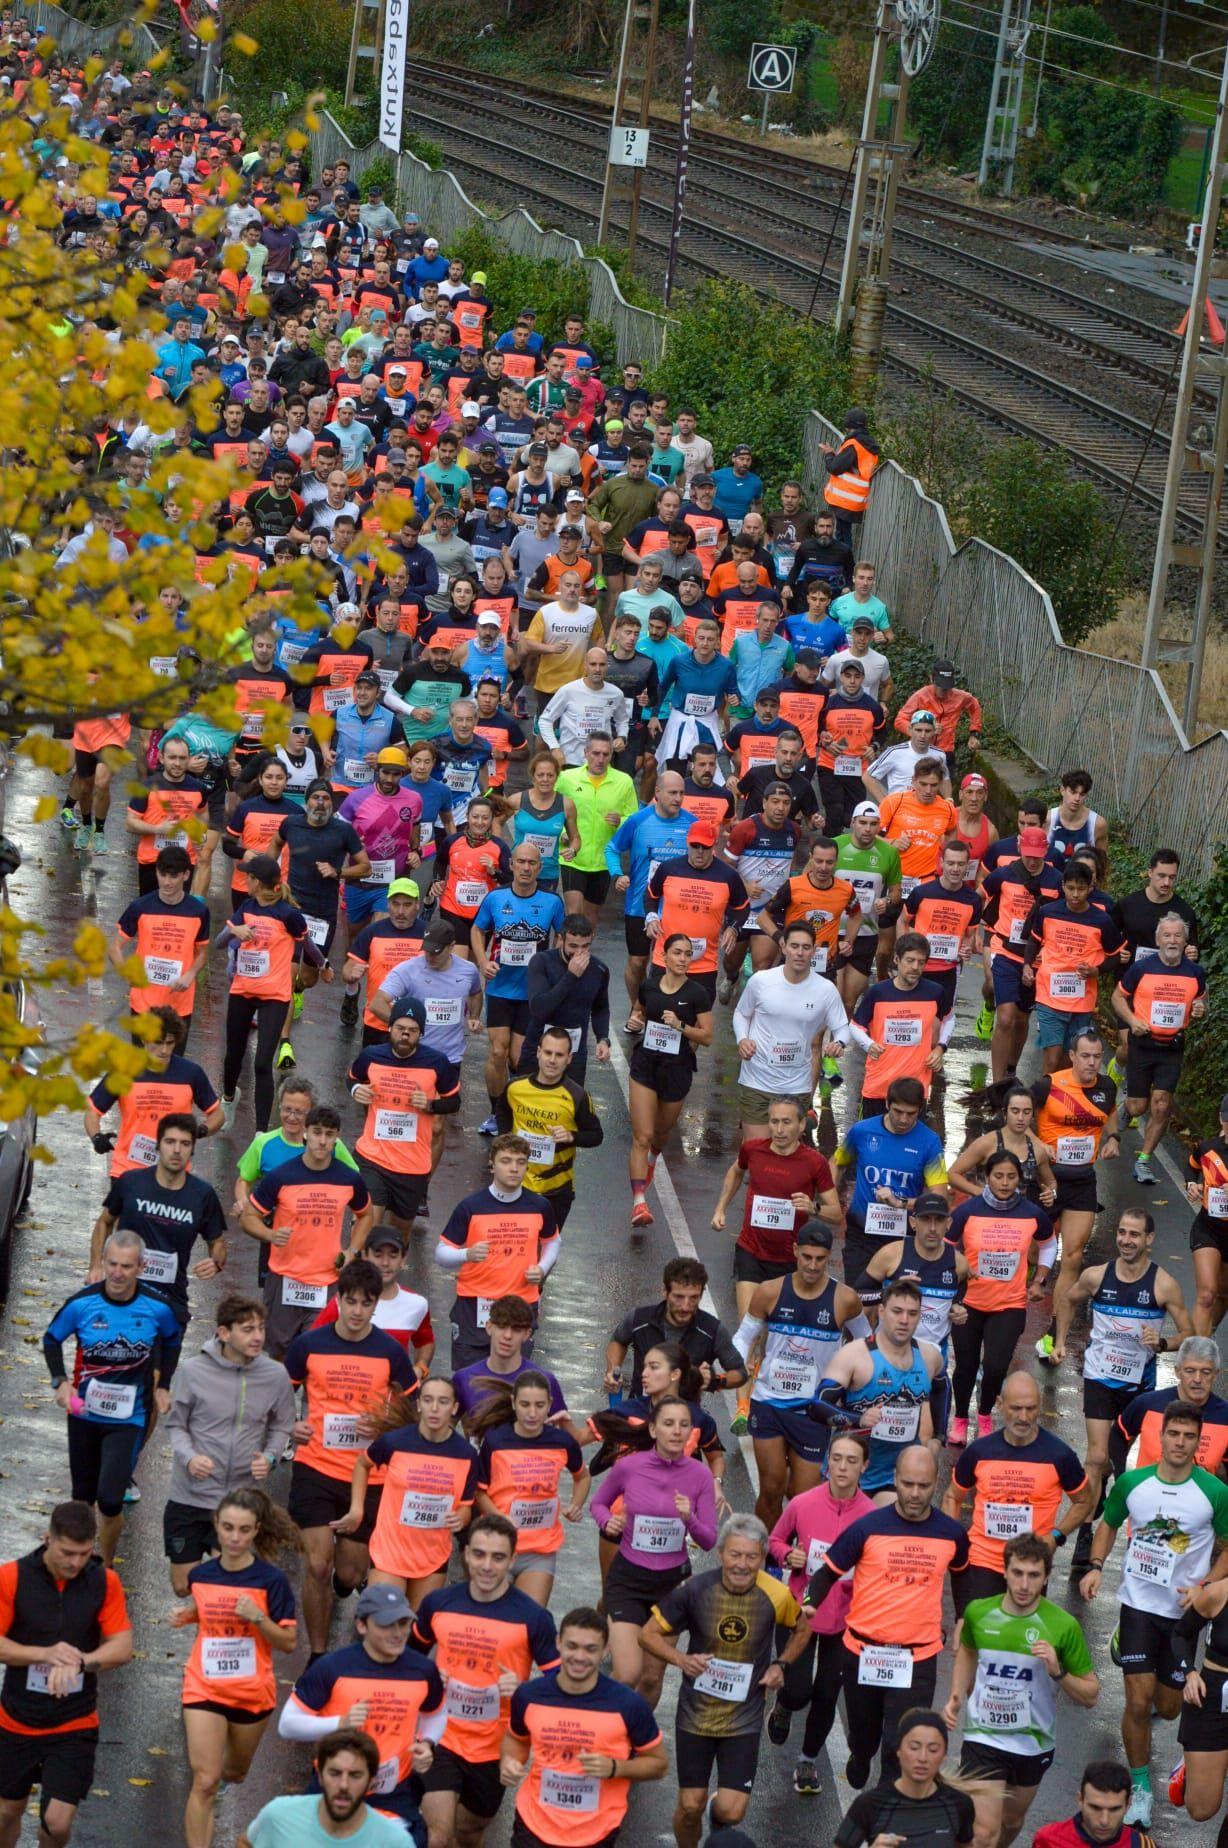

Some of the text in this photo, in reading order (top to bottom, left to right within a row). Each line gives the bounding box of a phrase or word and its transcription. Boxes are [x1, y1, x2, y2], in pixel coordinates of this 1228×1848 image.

[760, 52, 781, 82] A
[626, 130, 636, 142] 13
[626, 144, 632, 156] 2
[552, 622, 588, 634] ferrovial
[656, 1038, 667, 1048] 126
[388, 1126, 404, 1136] 566
[1068, 1152, 1084, 1160] 2162
[864, 1166, 914, 1188] OTT
[136, 1198, 193, 1224] YWNWA
[768, 1214, 779, 1224] 179
[878, 1221, 894, 1230] 1100
[989, 1266, 1009, 1276] 2549
[294, 1291, 315, 1302] 2306
[1111, 1364, 1132, 1376] 2397
[782, 1381, 802, 1392] 1892
[100, 1401, 117, 1411] 466
[888, 1426, 906, 1436] 659
[338, 1433, 359, 1443] 2791
[414, 1512, 438, 1522] 2886
[521, 1516, 544, 1525] 2882
[996, 1524, 1018, 1534] 1084
[650, 1536, 668, 1546] 347
[1140, 1563, 1158, 1576] 1154
[217, 1660, 240, 1671] 1313
[877, 1669, 894, 1680] 756
[986, 1664, 1032, 1682] LEA
[712, 1679, 734, 1692] 2181
[462, 1704, 483, 1715] 1221
[990, 1712, 1017, 1724] 3290
[558, 1792, 582, 1804] 1340
